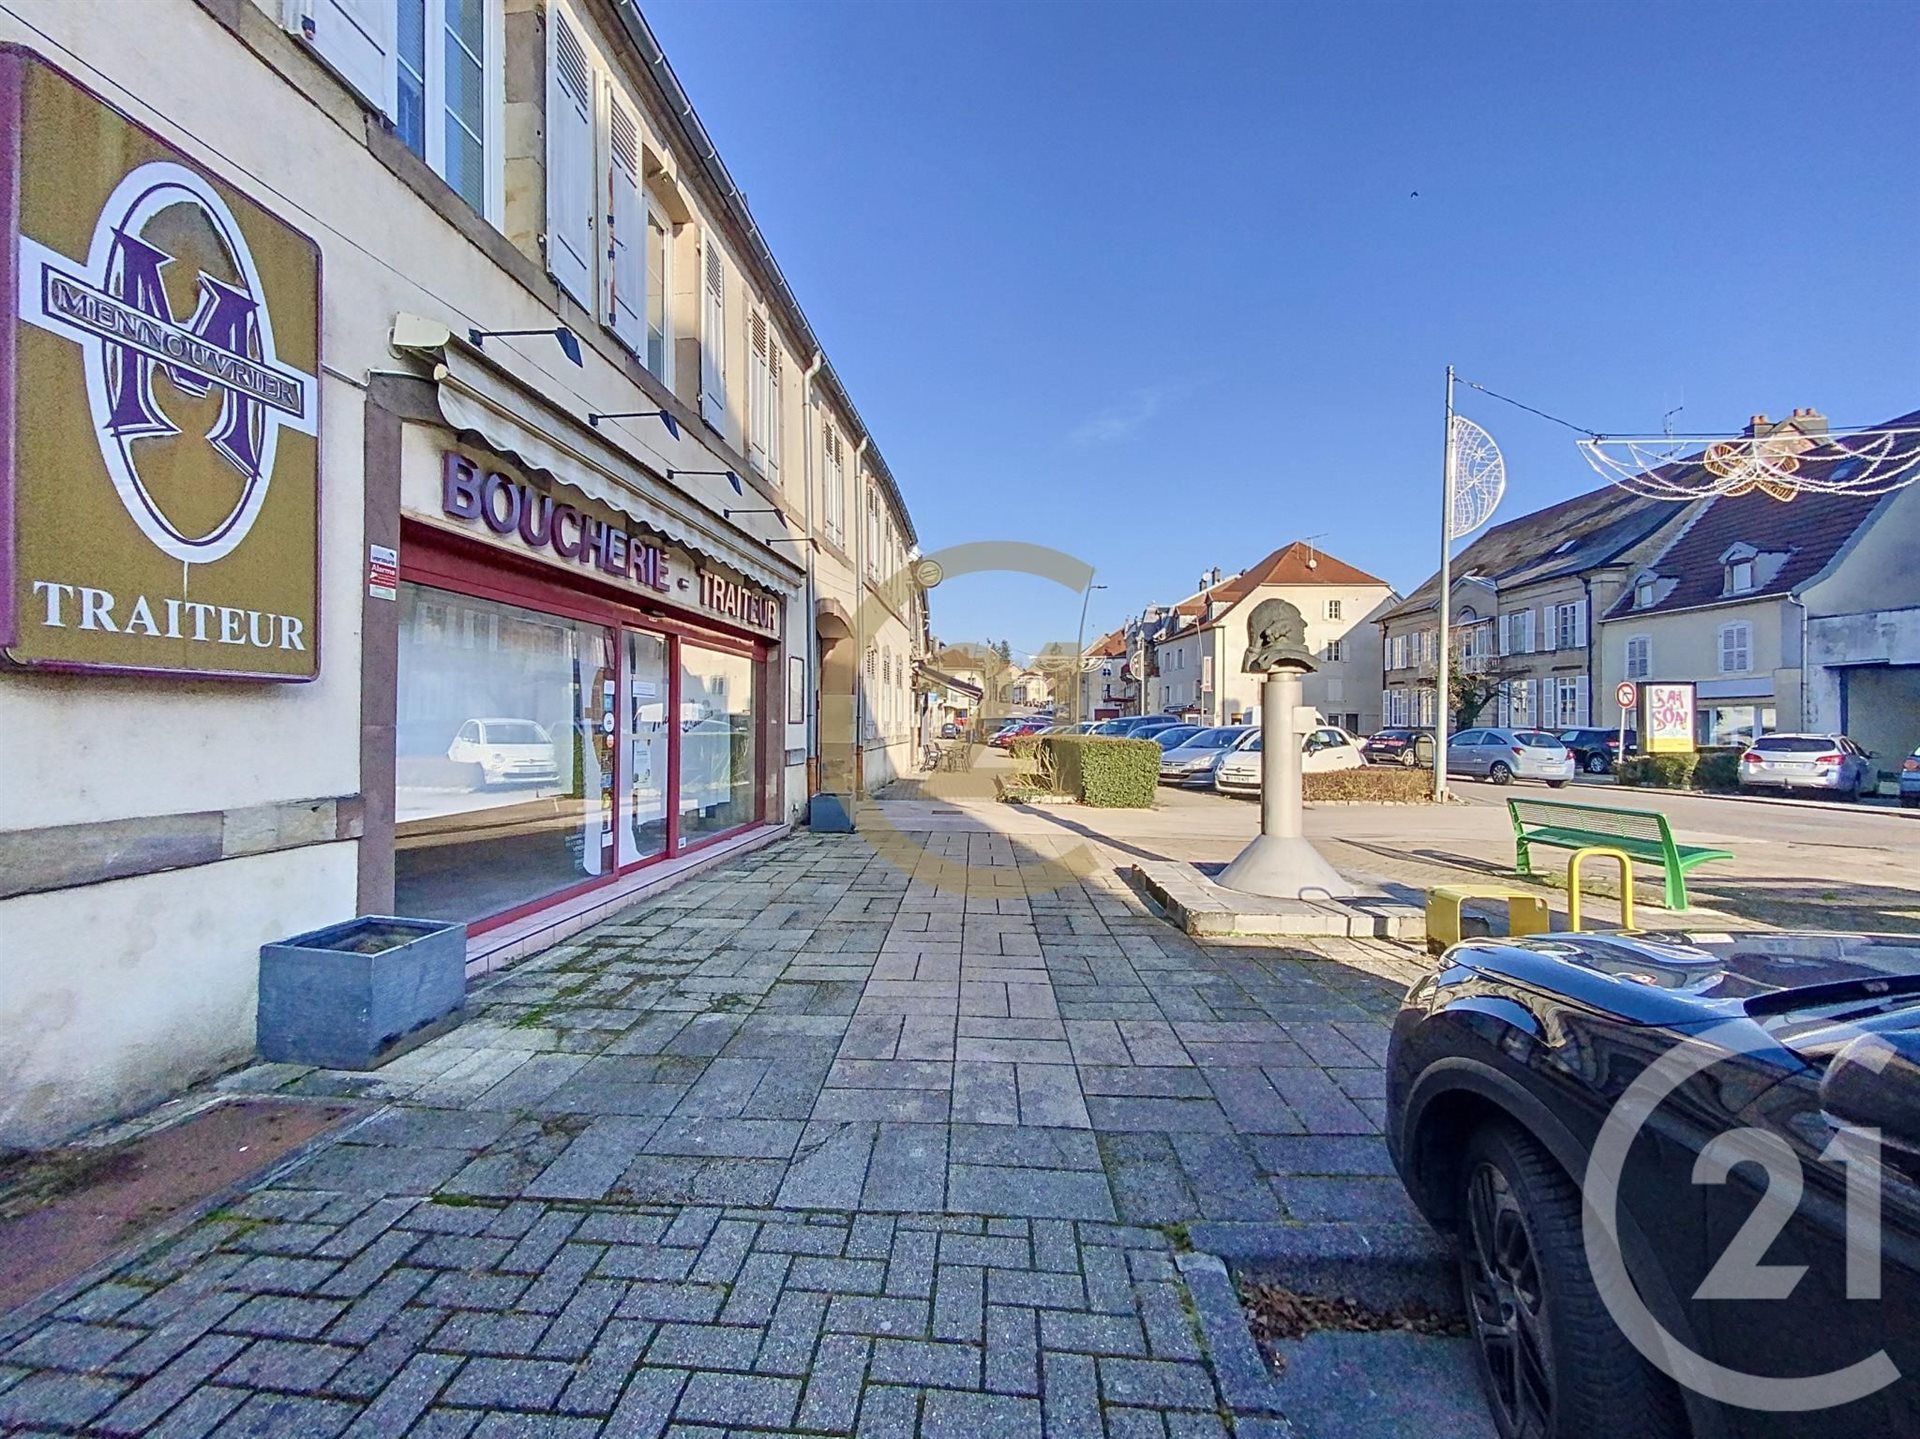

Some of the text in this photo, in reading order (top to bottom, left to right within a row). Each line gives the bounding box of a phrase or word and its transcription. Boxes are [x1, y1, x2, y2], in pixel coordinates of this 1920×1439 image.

[56, 281, 295, 404] MENNOUVRIER
[443, 451, 671, 593] BOUCHERIE
[699, 567, 778, 631] TRAITEUR
[33, 581, 306, 651] TRAITEUR
